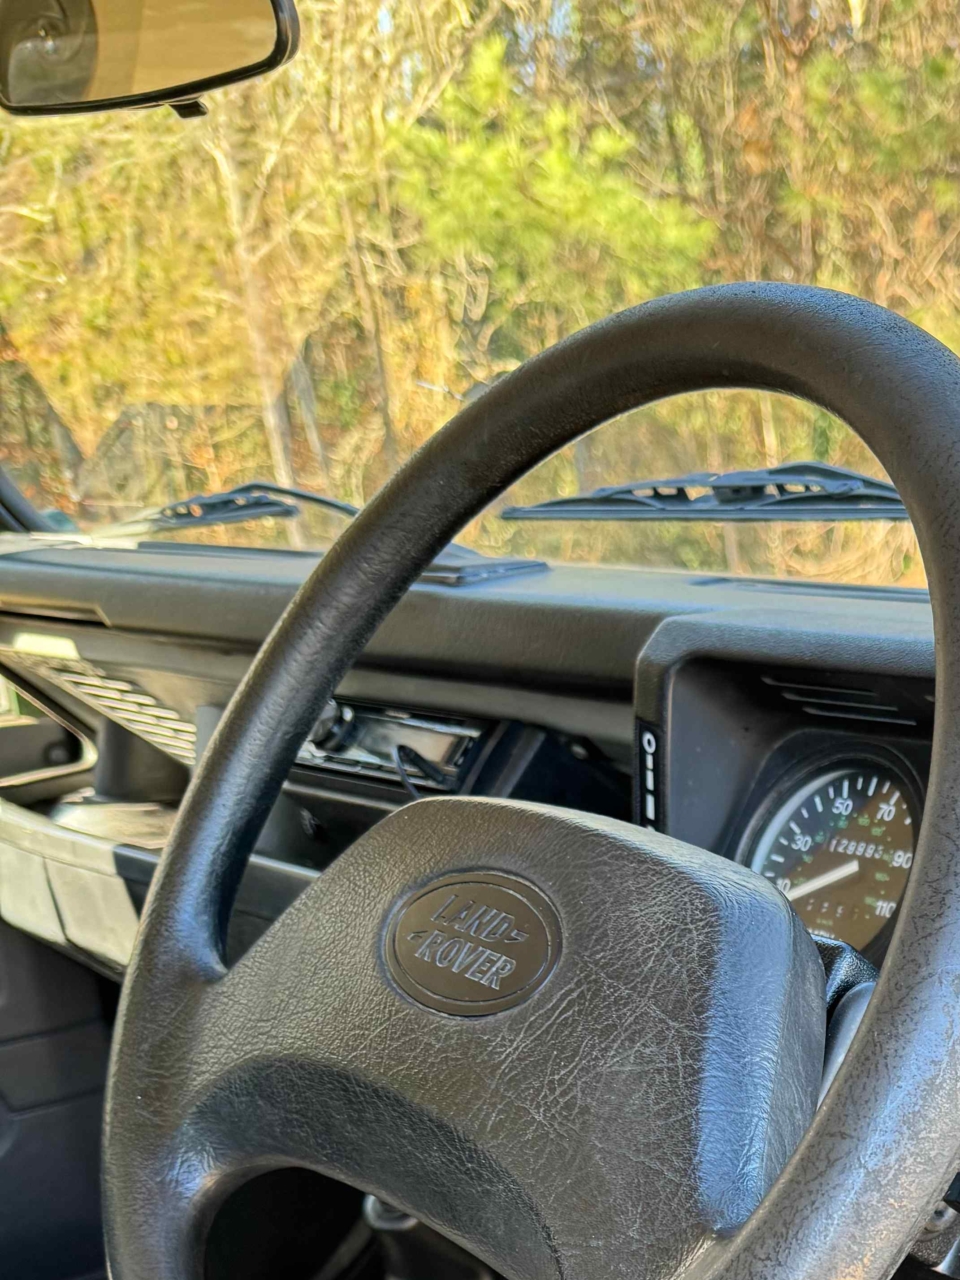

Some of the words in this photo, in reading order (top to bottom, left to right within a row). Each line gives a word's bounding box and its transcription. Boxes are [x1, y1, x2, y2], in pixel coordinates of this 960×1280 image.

[832, 800, 853, 815] 50
[876, 803, 896, 821] 70
[791, 835, 812, 851] 30
[891, 851, 913, 868] 90
[431, 894, 516, 942] LAND
[875, 901, 897, 918] 110
[414, 930, 517, 990] ROVER
